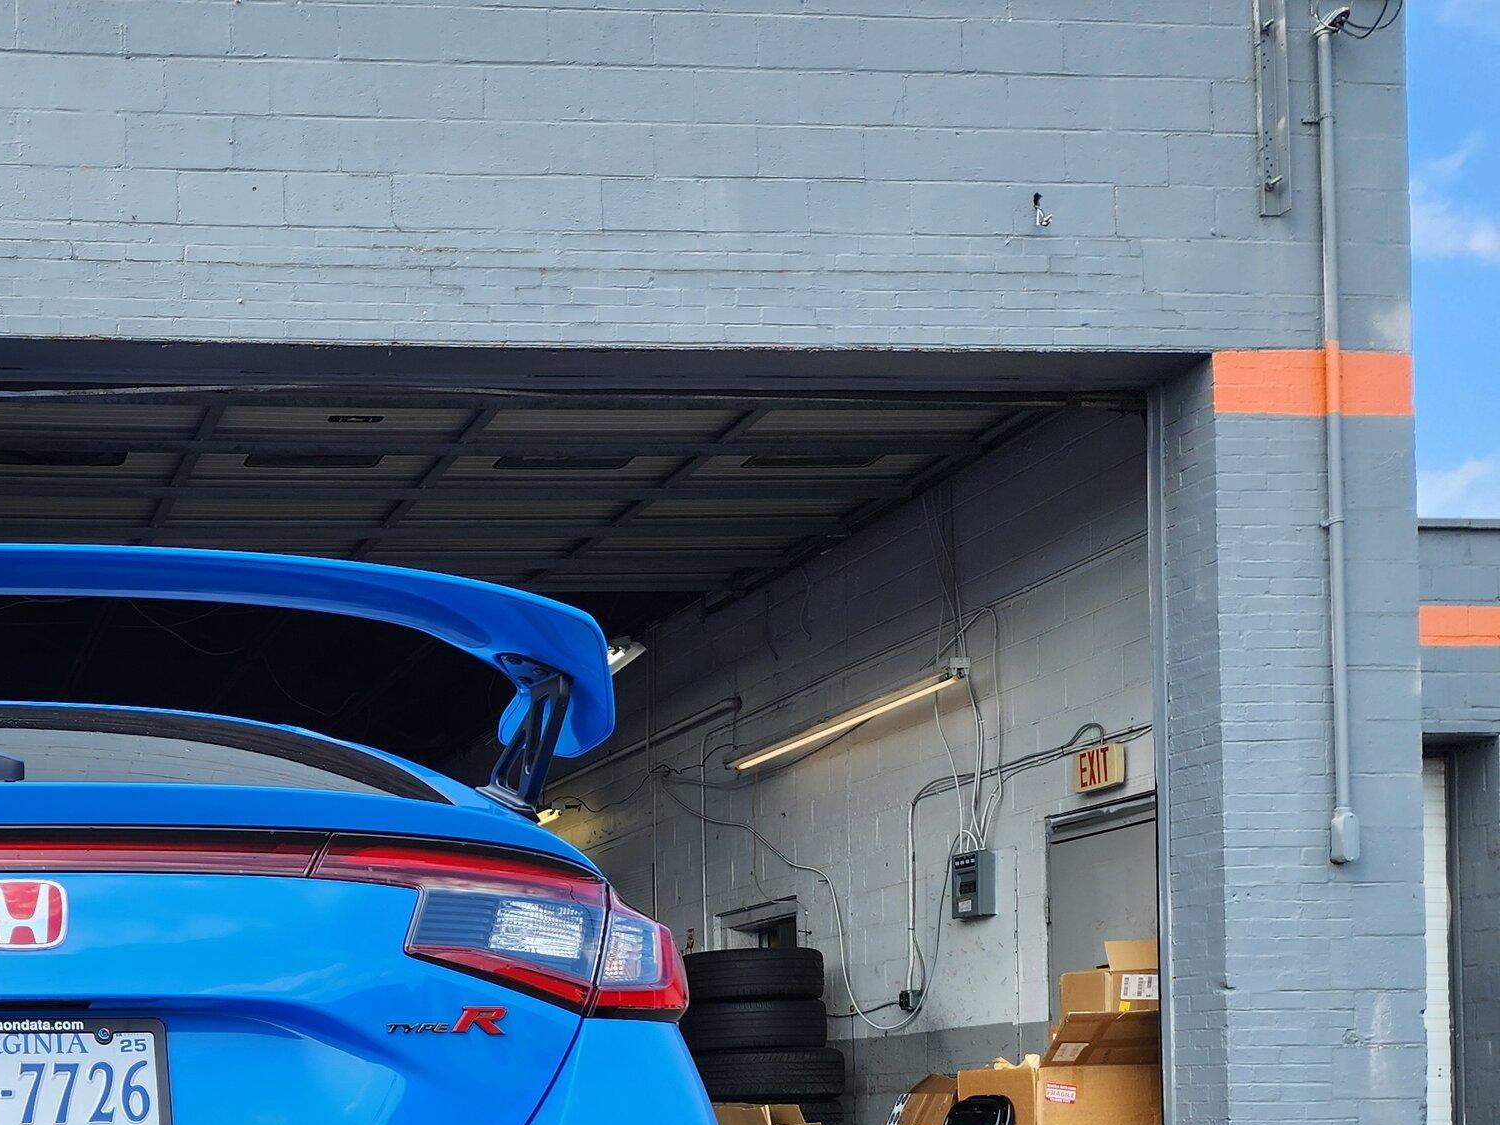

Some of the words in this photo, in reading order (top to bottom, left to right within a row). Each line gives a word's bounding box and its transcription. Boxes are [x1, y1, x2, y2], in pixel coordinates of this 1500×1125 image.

[1079, 746, 1109, 788] EXIT
[386, 1022, 449, 1034] TYPE
[451, 1005, 508, 1035] R
[120, 1038, 148, 1052] 25
